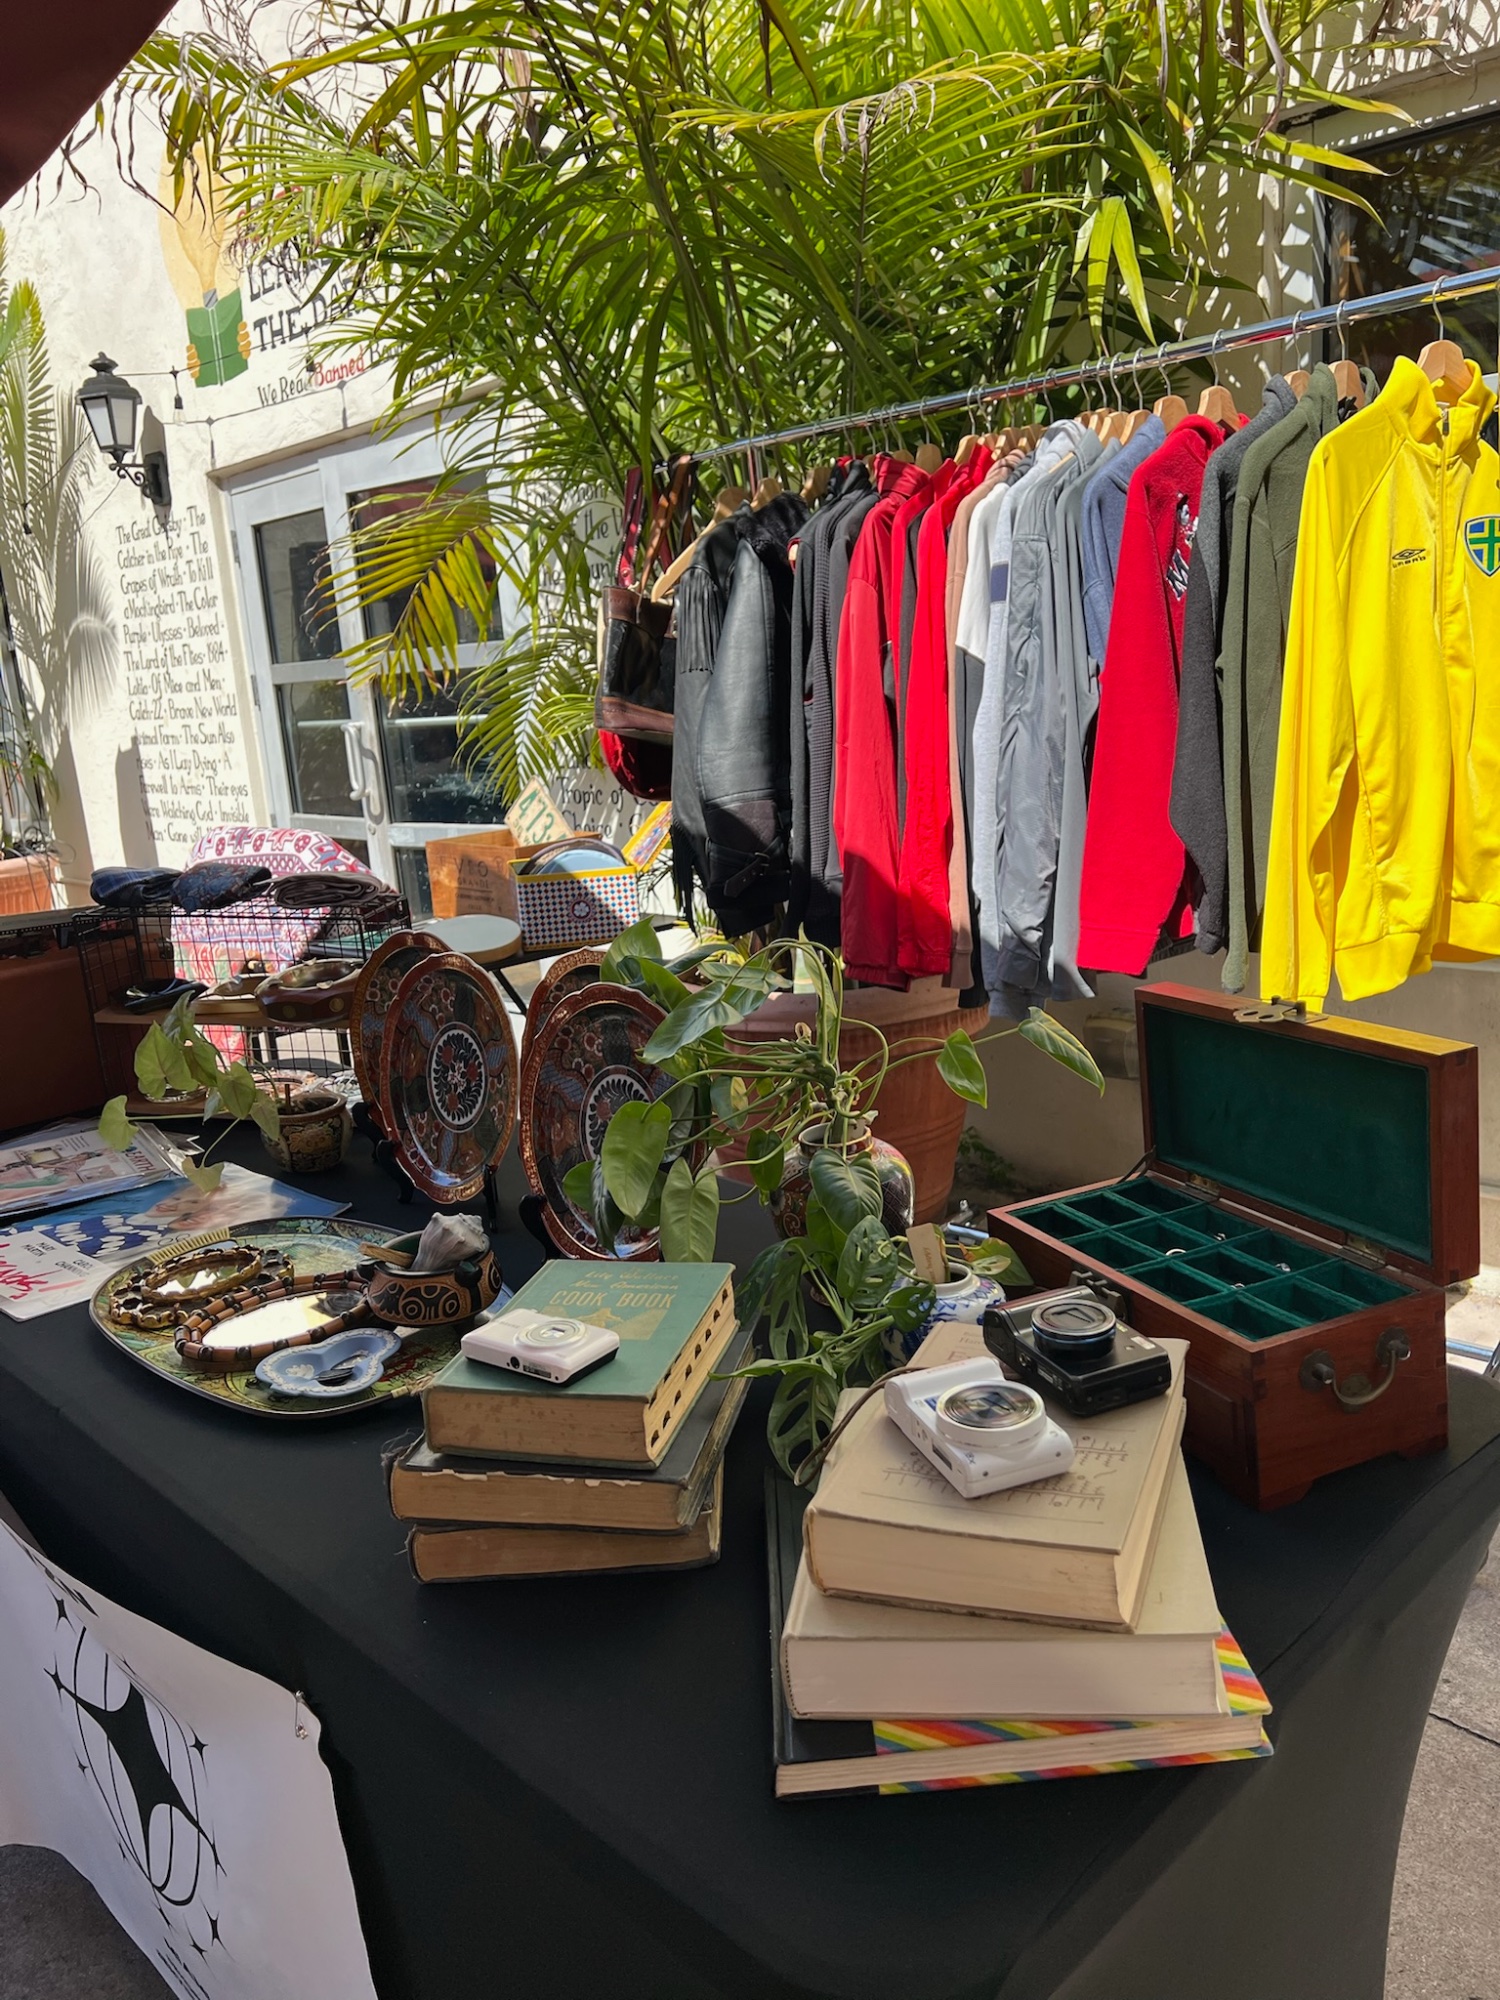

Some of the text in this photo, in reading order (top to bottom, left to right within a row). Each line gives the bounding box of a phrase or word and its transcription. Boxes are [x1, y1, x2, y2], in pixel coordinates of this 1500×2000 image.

[253, 306, 305, 351] THE
[257, 384, 277, 406] We
[314, 345, 366, 386] Banned
[115, 525, 131, 545] The
[131, 517, 151, 541] Great
[186, 505, 206, 527] The
[584, 508, 610, 541] the
[117, 546, 145, 570] Catcher
[153, 541, 167, 562] the
[166, 536, 183, 563] Rye
[189, 531, 209, 555] The
[120, 556, 214, 598] Grapes of Wrath To Kill
[177, 590, 194, 614] The
[193, 585, 218, 610] Color
[123, 612, 220, 649] Purple Ulysses Beloved
[123, 651, 140, 672] The
[139, 647, 159, 670] Lord
[169, 644, 182, 668] the
[182, 643, 204, 666] Flies
[207, 641, 225, 663] 1984
[127, 668, 222, 700] Lolita Of Mice and Men
[167, 698, 194, 720] Brave
[193, 696, 213, 719] New
[212, 693, 237, 717] World
[158, 724, 181, 746] Farm
[181, 724, 200, 745] The
[198, 722, 217, 744] Sun
[218, 721, 235, 744] Also
[158, 751, 170, 770] As
[173, 749, 192, 776] Lay
[192, 749, 219, 778] Dying
[223, 750, 232, 771] A
[179, 774, 202, 796] Arms
[206, 776, 229, 796] Their
[231, 784, 249, 802] eyes
[555, 776, 603, 810] Tropic
[611, 786, 625, 813] of
[160, 799, 197, 826] Watching
[195, 800, 213, 821] God
[219, 799, 250, 824] Invisible
[167, 822, 188, 843] Gone
[549, 1289, 677, 1310] COOK BOOK
[608, 1281, 680, 1291] American
